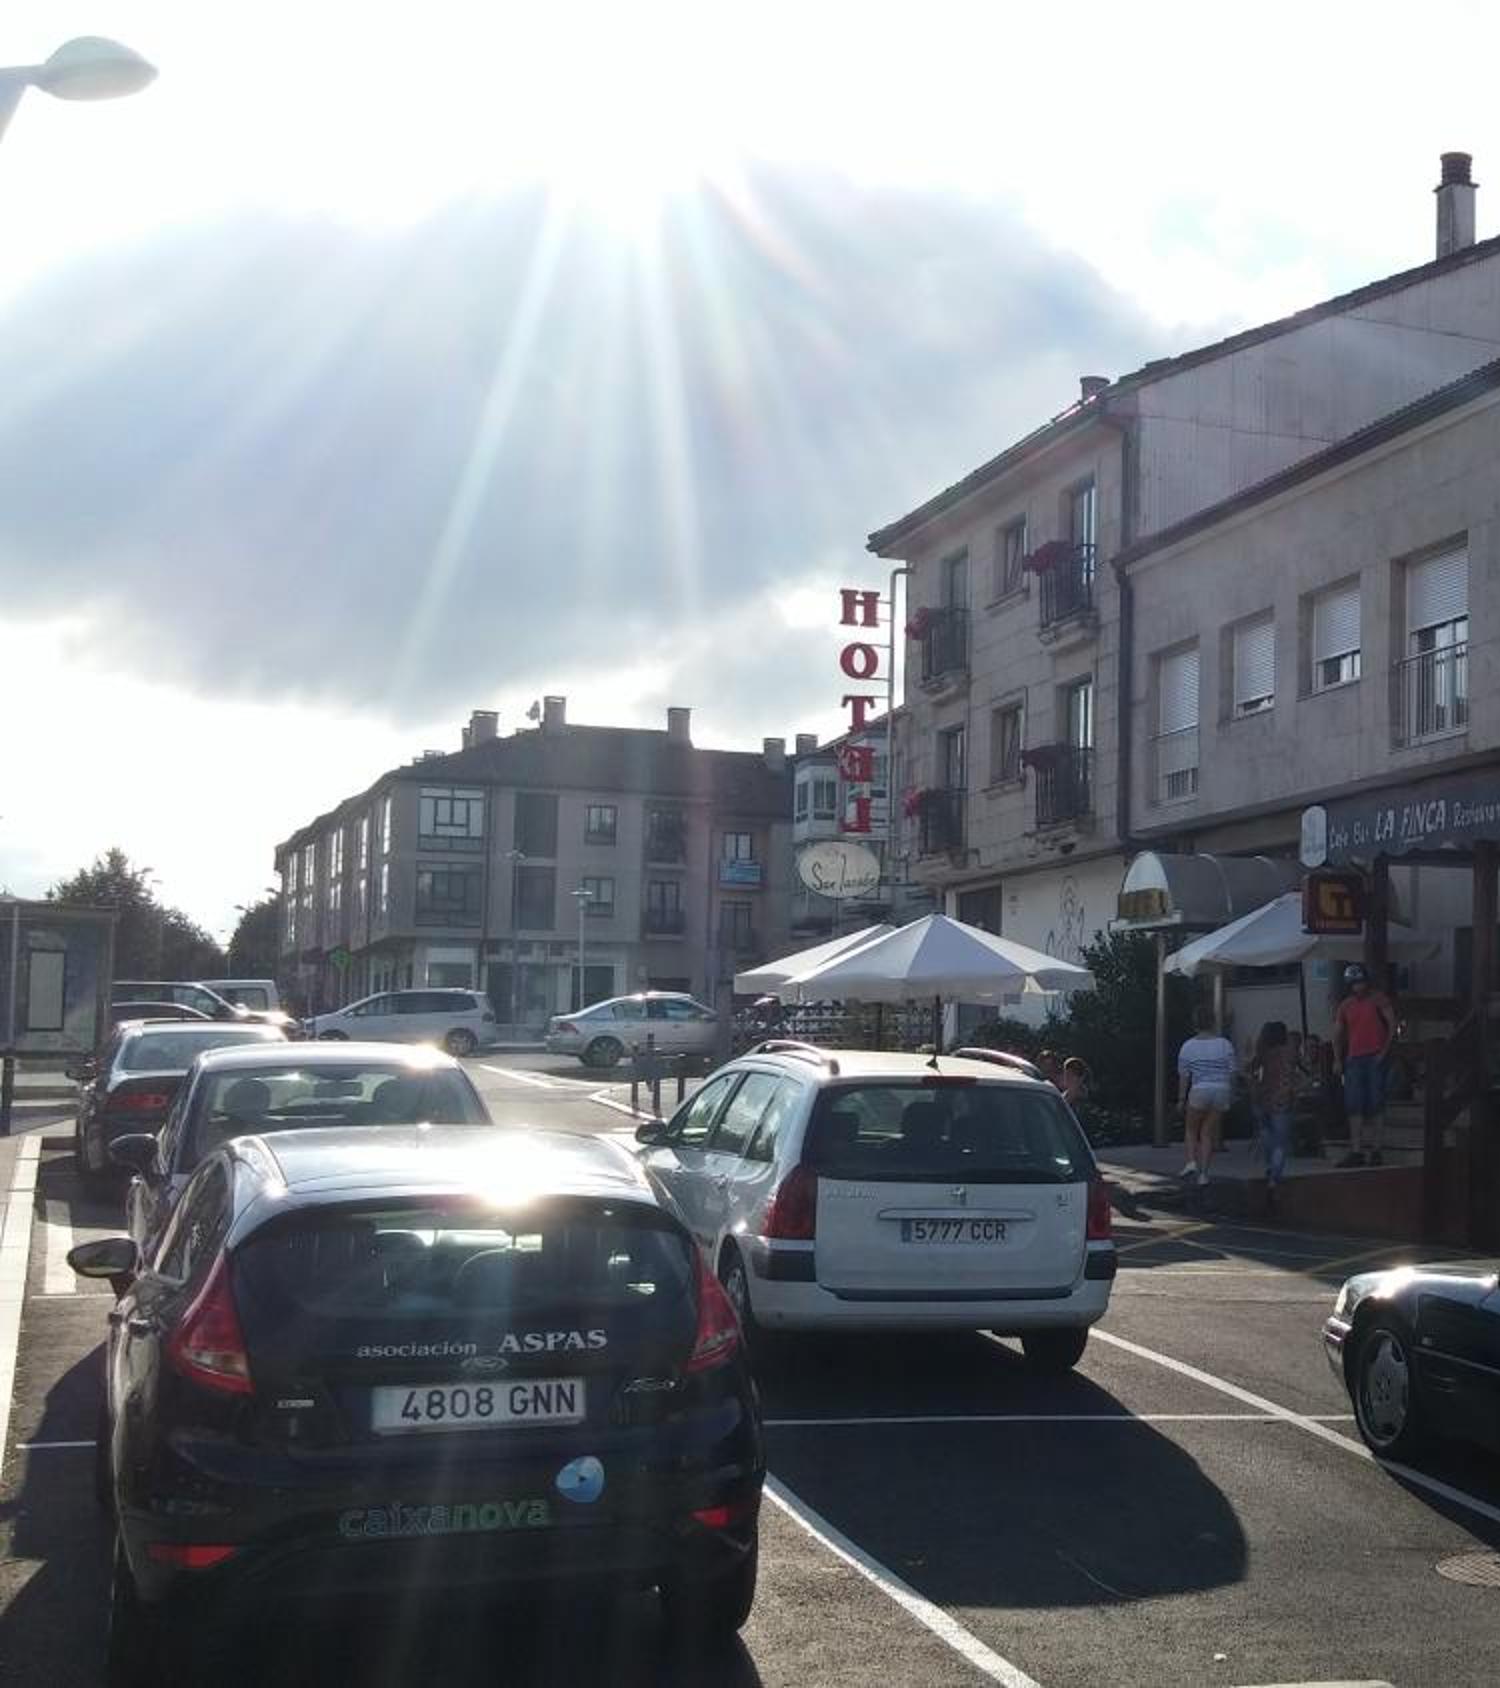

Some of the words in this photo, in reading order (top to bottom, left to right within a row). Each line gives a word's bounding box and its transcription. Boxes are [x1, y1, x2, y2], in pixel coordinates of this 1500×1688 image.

[1375, 810, 1395, 840] LA
[1400, 799, 1446, 838] FINCA
[915, 1221, 962, 1240] 5777
[970, 1222, 1006, 1241] CCR
[499, 1329, 608, 1353] ASPAS
[401, 1387, 494, 1421] 4808
[508, 1384, 576, 1416] GNN
[337, 1499, 551, 1538] caixanova
